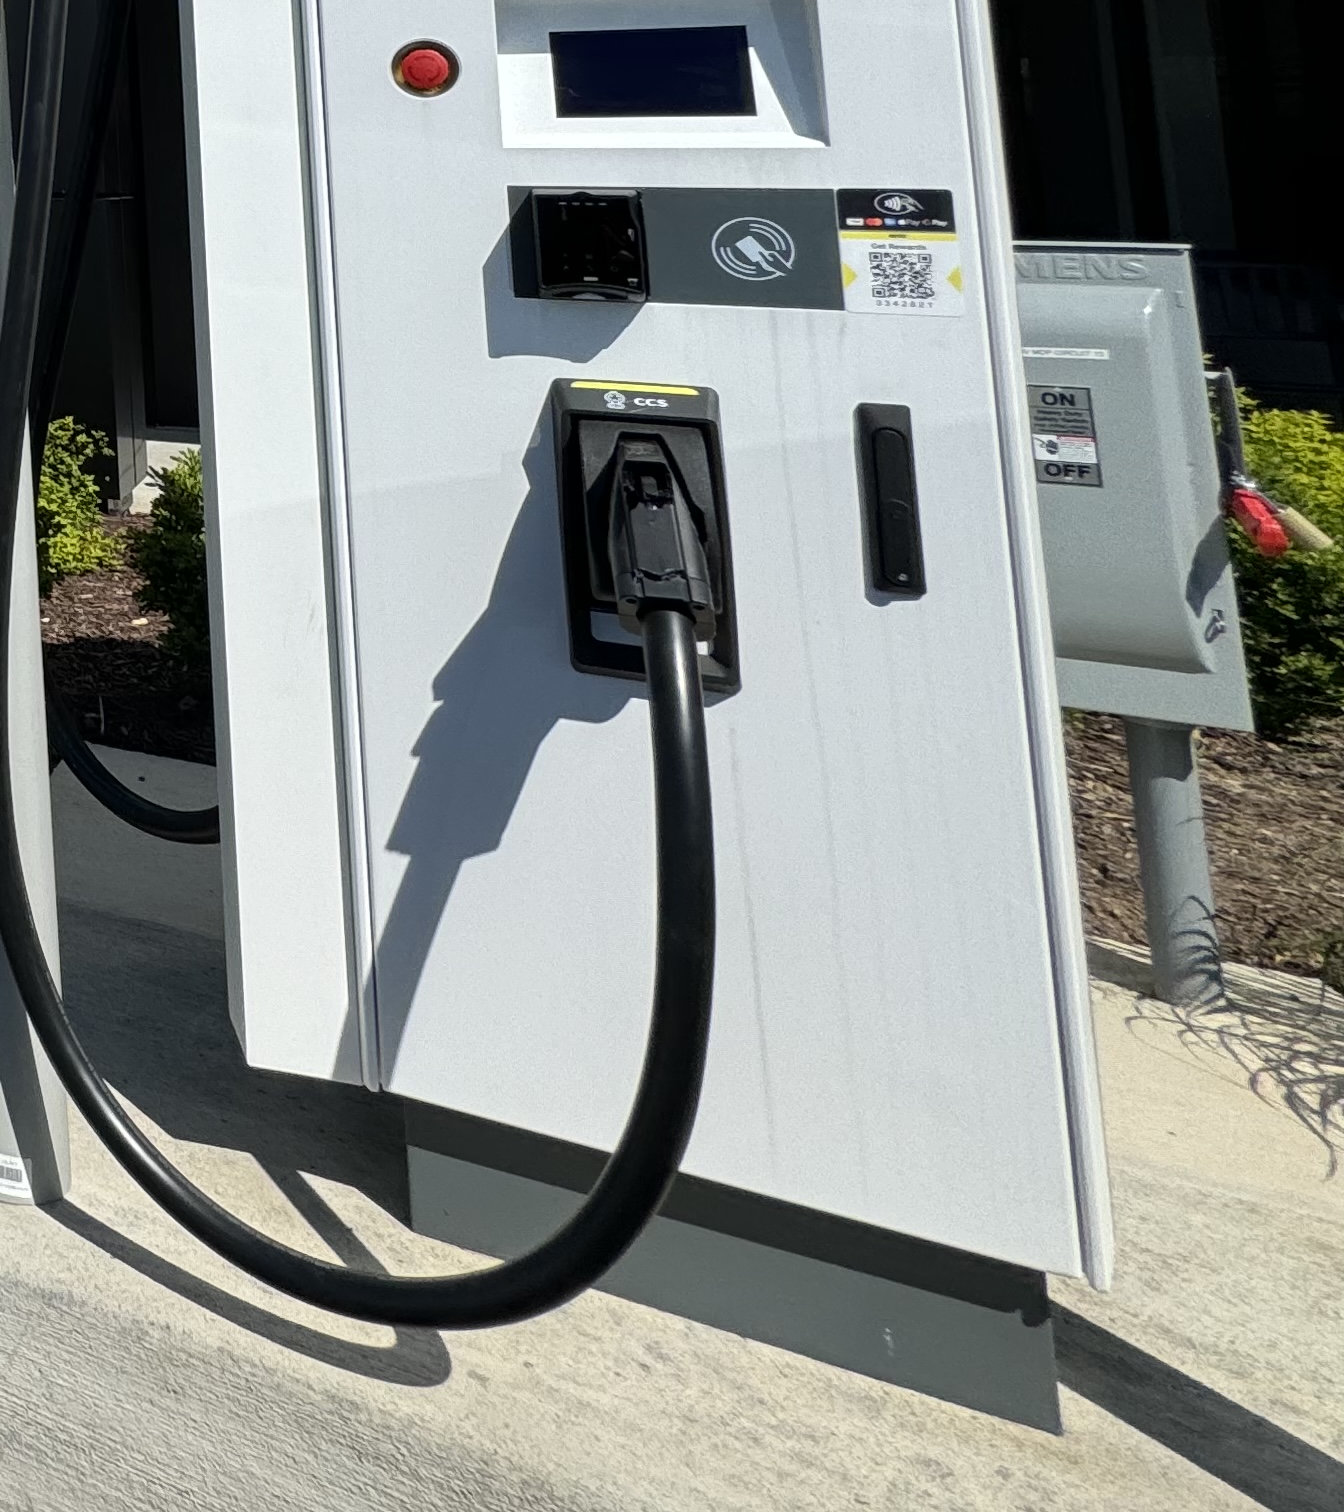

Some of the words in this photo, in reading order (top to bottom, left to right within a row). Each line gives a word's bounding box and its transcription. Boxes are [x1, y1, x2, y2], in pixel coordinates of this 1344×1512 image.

[1014, 253, 1148, 281] MENS
[633, 397, 669, 408] CCS
[1041, 392, 1076, 407] ON
[1044, 463, 1091, 478] OFF
